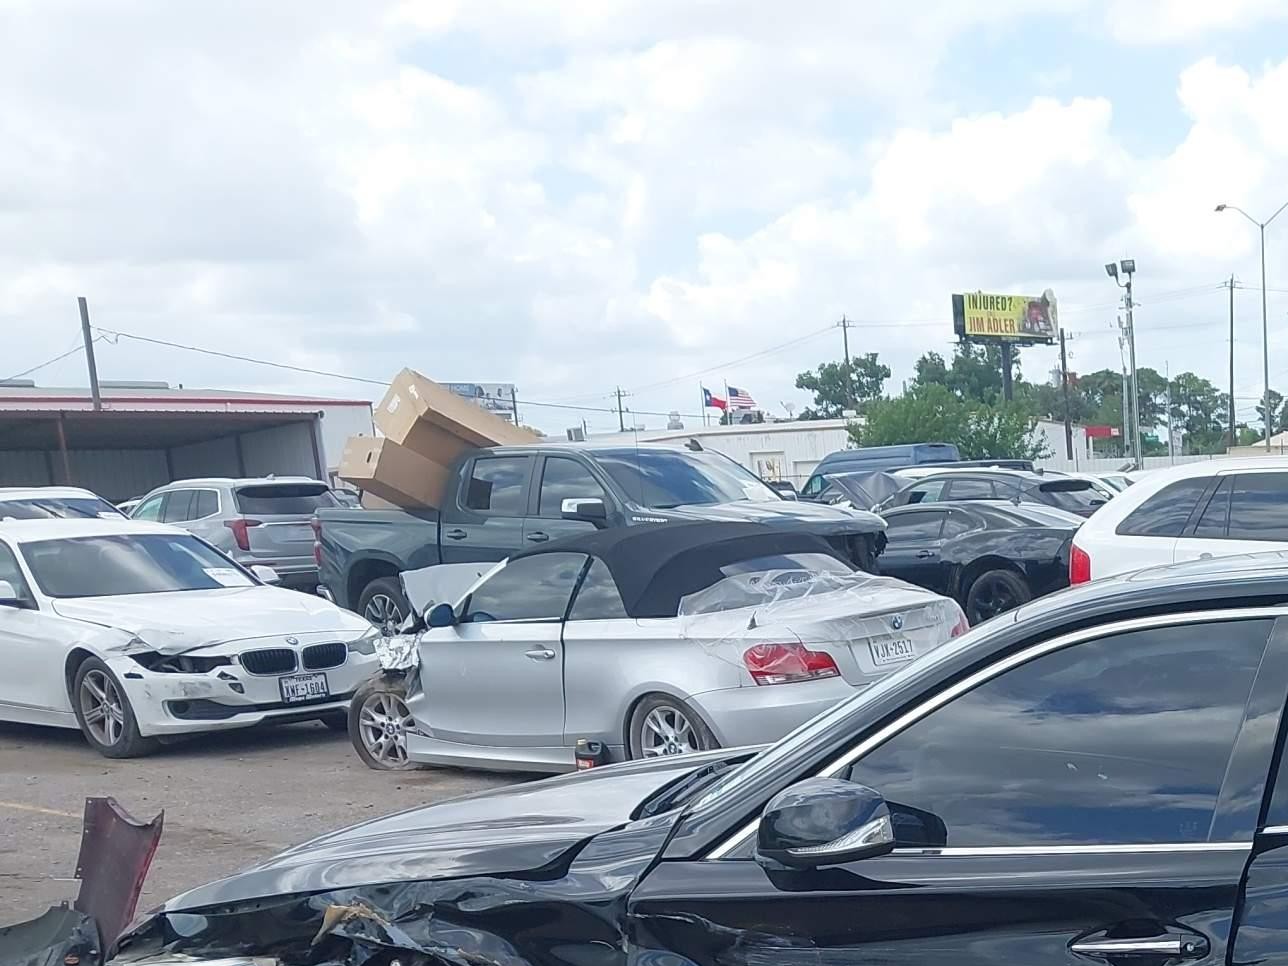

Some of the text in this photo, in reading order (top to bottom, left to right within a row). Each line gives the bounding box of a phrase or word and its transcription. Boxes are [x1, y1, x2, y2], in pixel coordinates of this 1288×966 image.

[968, 294, 1013, 312] INJURED?
[969, 316, 1016, 334] JIM ADLER
